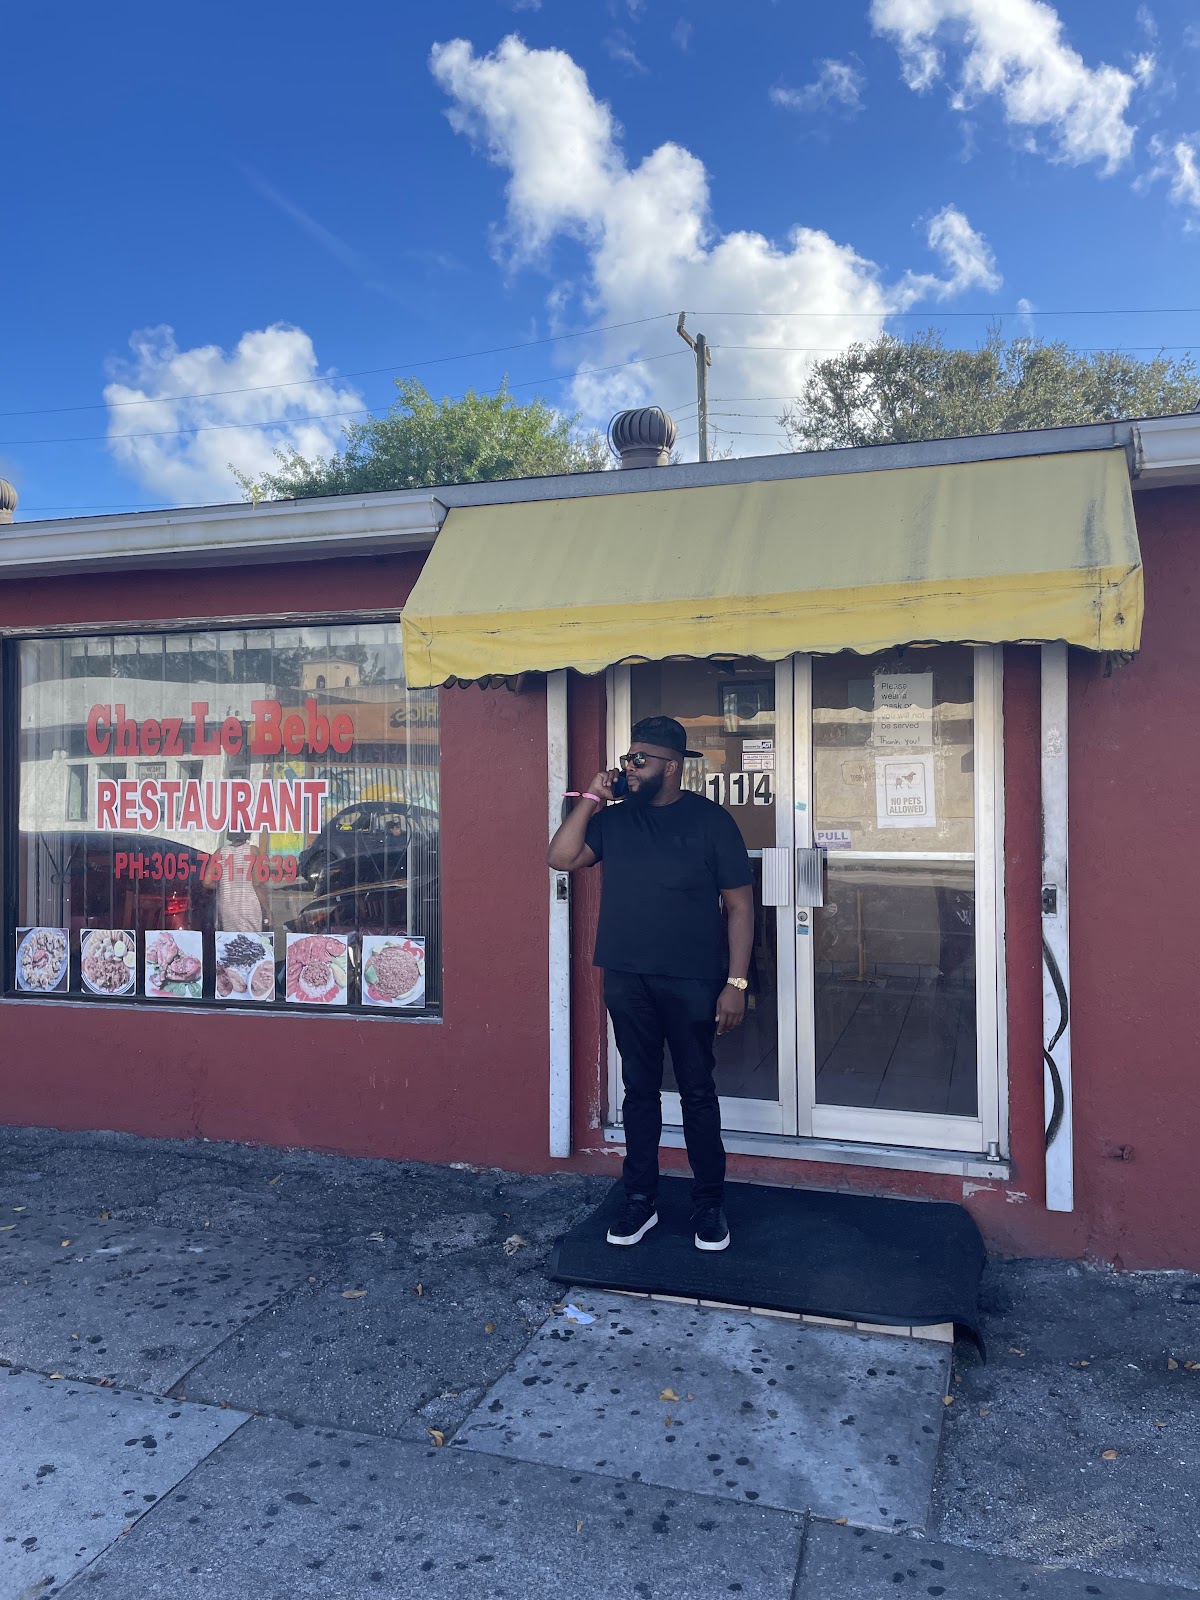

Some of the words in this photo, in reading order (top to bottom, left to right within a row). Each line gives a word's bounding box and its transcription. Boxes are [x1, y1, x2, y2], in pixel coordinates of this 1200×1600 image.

[881, 713, 896, 721] you
[86, 703, 184, 756] Chez
[191, 701, 243, 756] Le
[251, 698, 354, 755] Bebe
[709, 774, 772, 804] 114
[903, 797, 922, 805] PETS
[95, 778, 329, 834] RESTAURANT
[889, 805, 924, 814] ALLOWED
[817, 832, 849, 840] PULL
